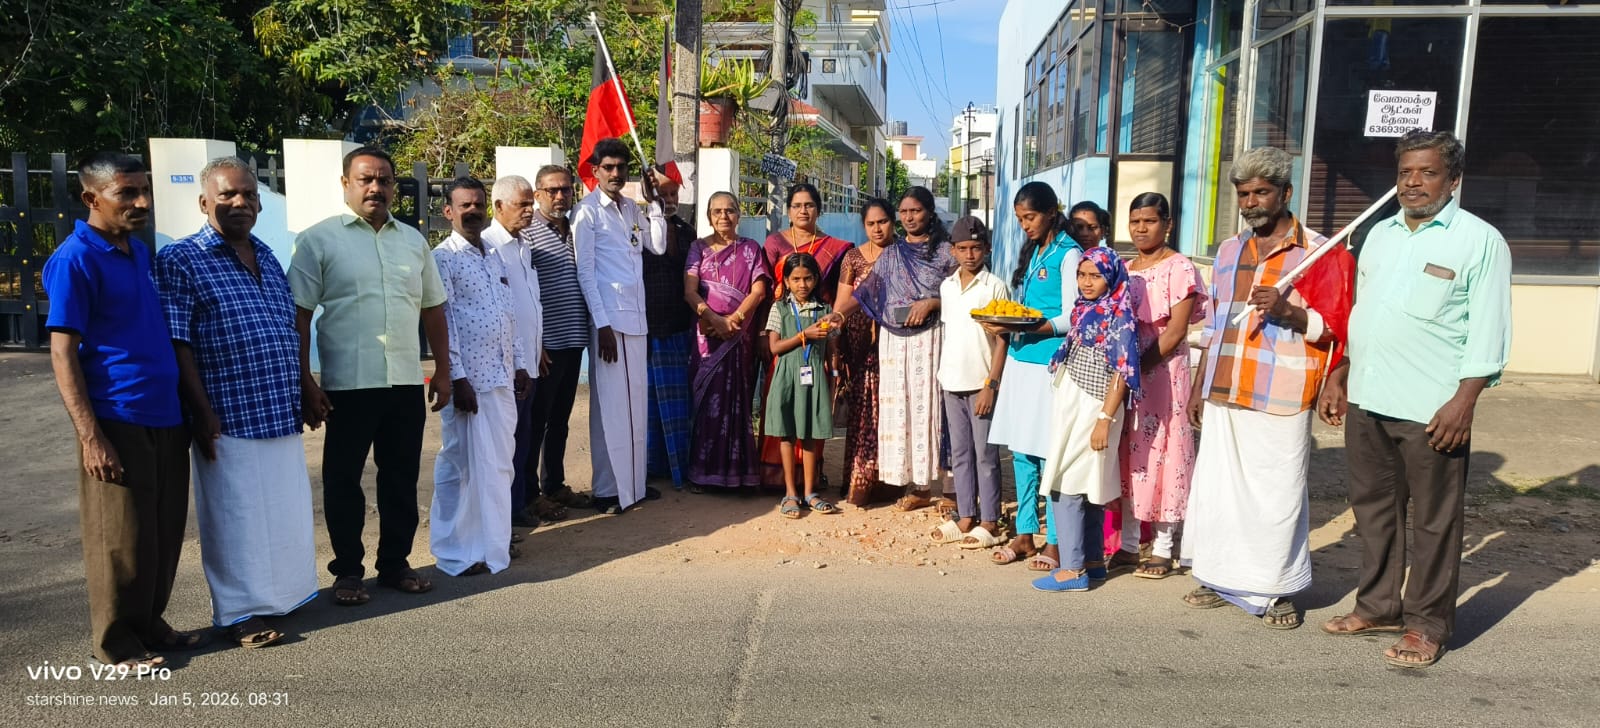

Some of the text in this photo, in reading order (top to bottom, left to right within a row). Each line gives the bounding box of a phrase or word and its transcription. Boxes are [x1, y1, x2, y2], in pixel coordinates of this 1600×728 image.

[1373, 93, 1432, 106] வேலைக்கு
[1381, 104, 1422, 115] ஆட்கள்
[1381, 114, 1420, 125] தேவை
